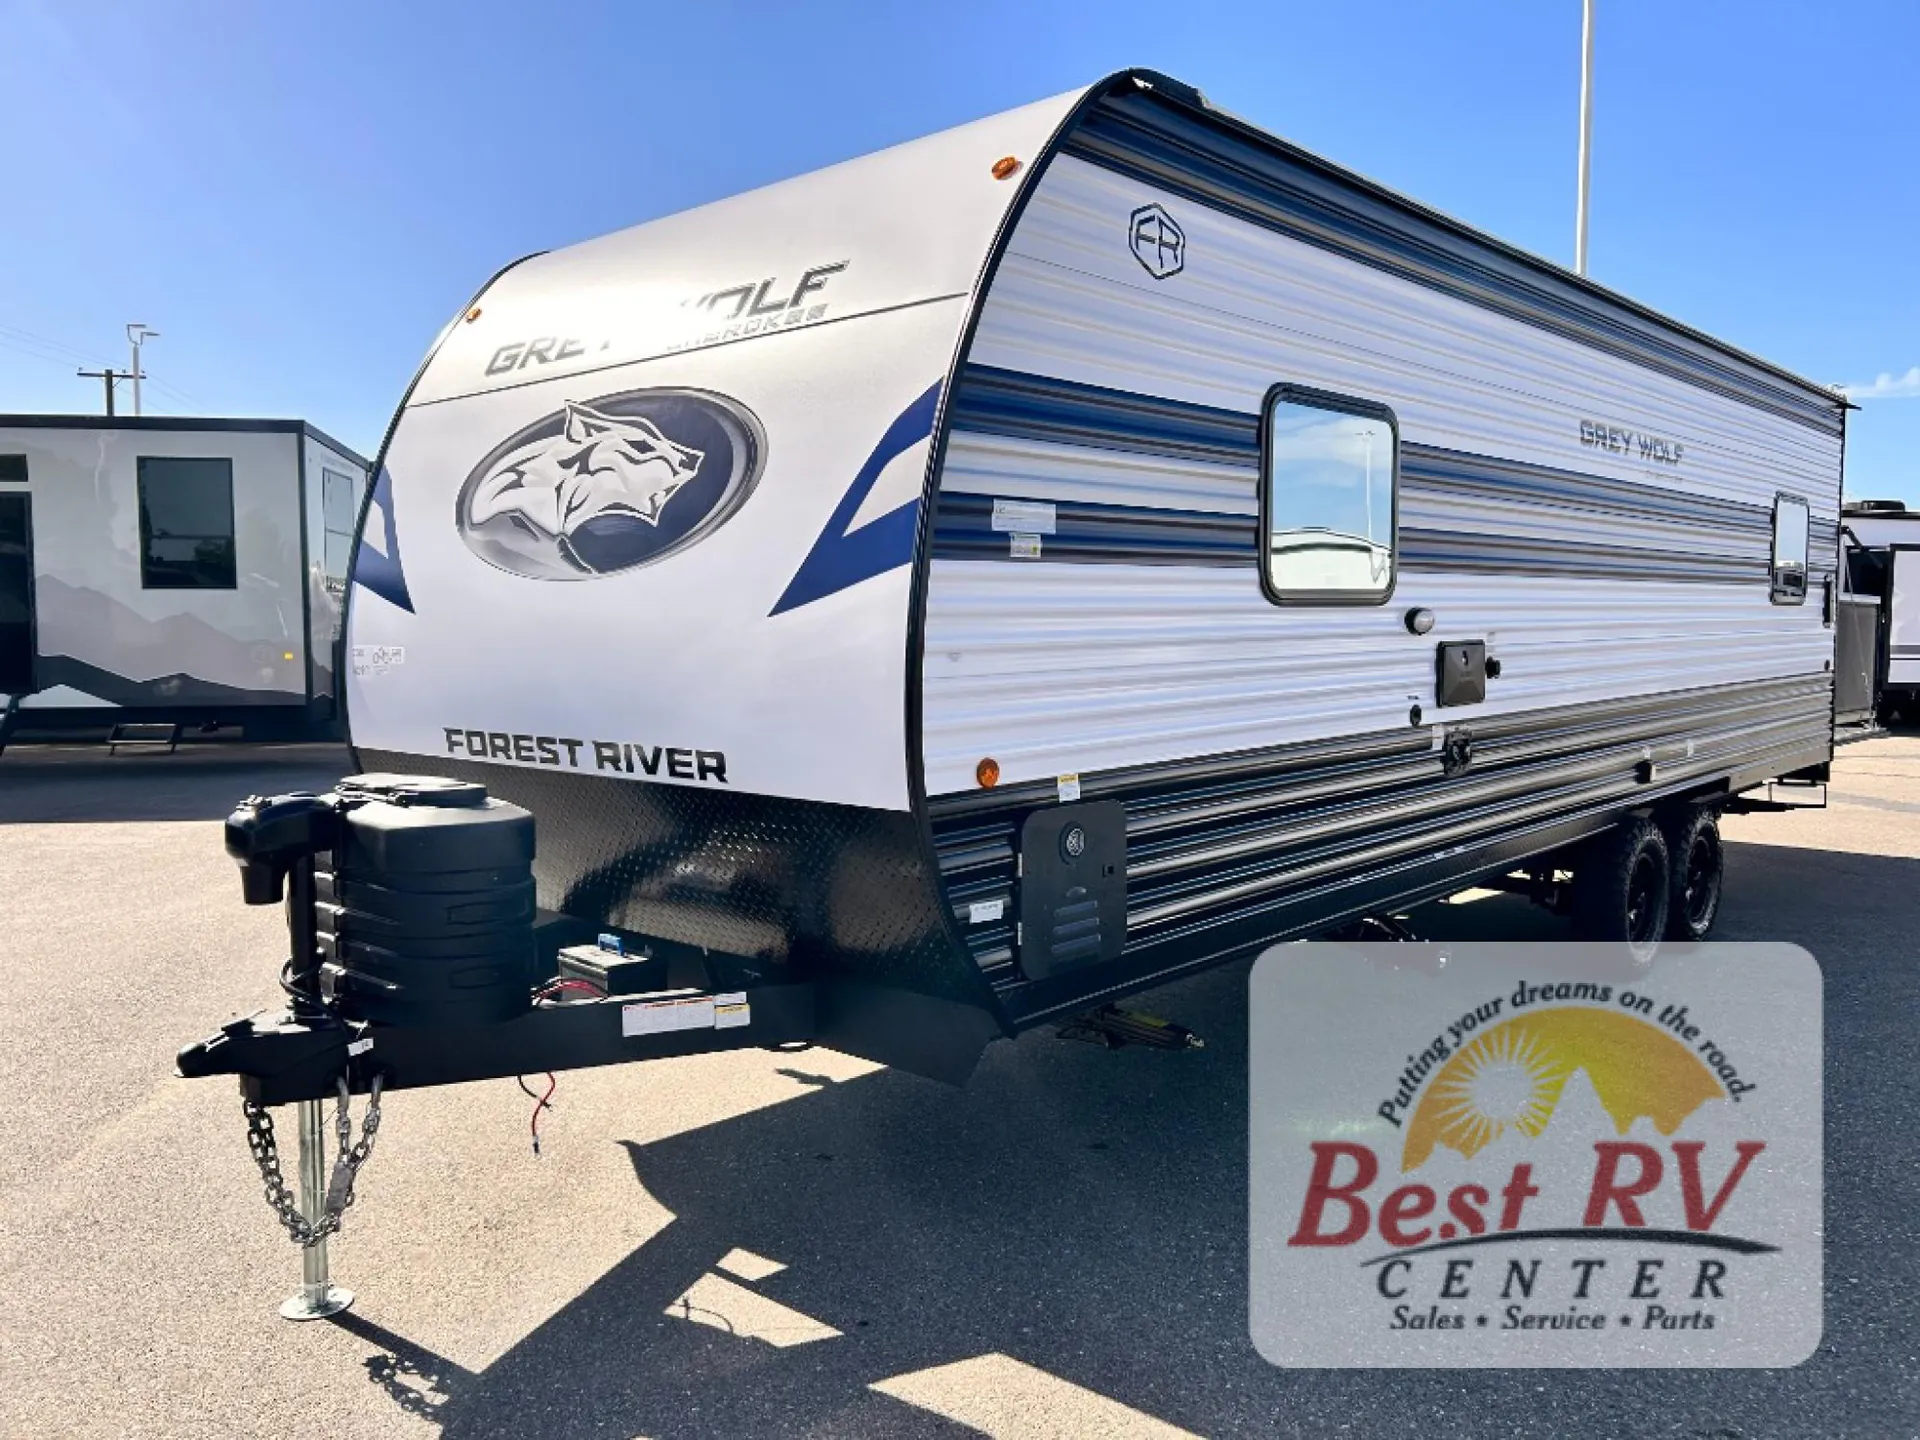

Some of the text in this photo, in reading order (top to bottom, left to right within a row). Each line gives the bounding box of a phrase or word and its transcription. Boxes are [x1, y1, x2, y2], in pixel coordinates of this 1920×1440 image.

[484, 257, 850, 377] GRE OLF
[1580, 419, 1684, 466] GREY WOLF
[442, 727, 729, 784] FOREST RIVER
